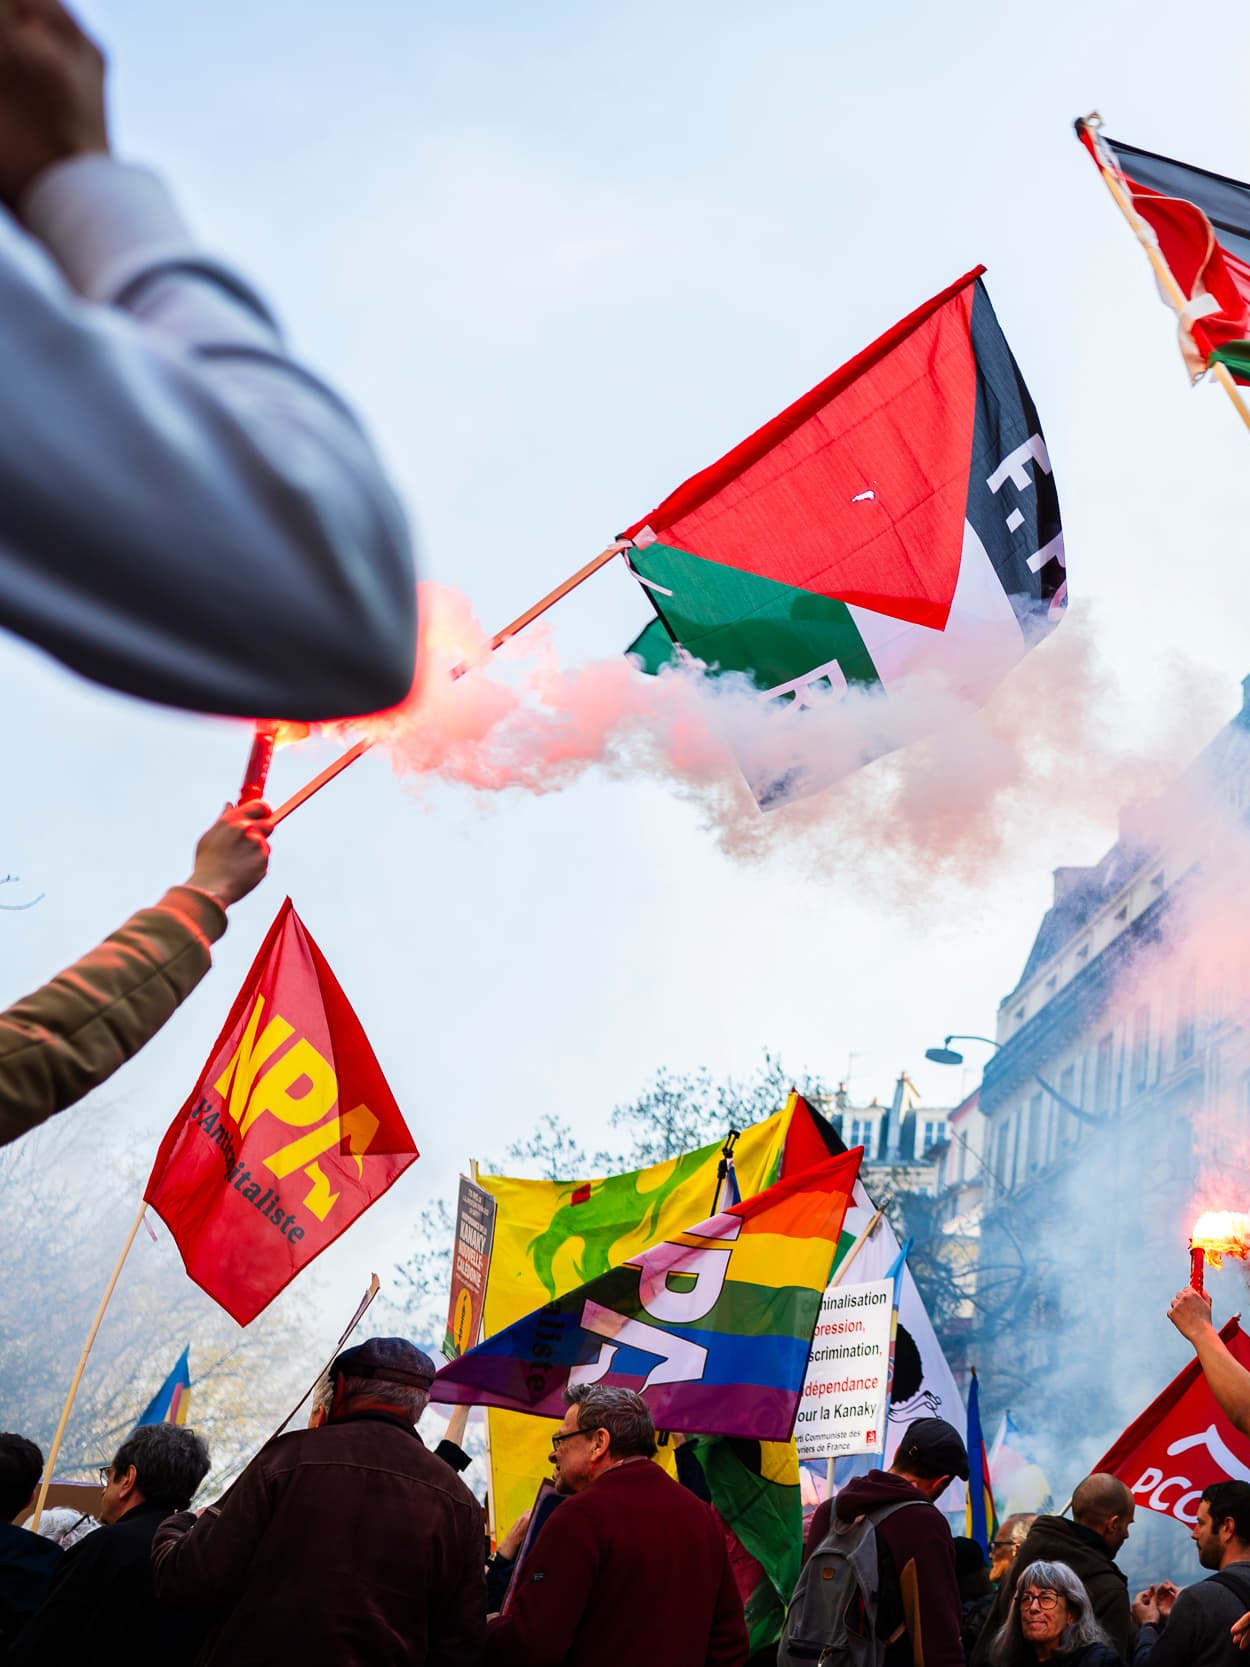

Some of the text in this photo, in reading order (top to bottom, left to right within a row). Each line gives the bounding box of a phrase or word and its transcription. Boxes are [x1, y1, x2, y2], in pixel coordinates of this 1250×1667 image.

[808, 1342, 882, 1362] scrimination,
[797, 1401, 877, 1423] our la Kanaky
[804, 1431, 847, 1442] Communiste
[849, 1430, 861, 1438] des
[817, 1444, 825, 1452] de
[826, 1442, 850, 1451] France
